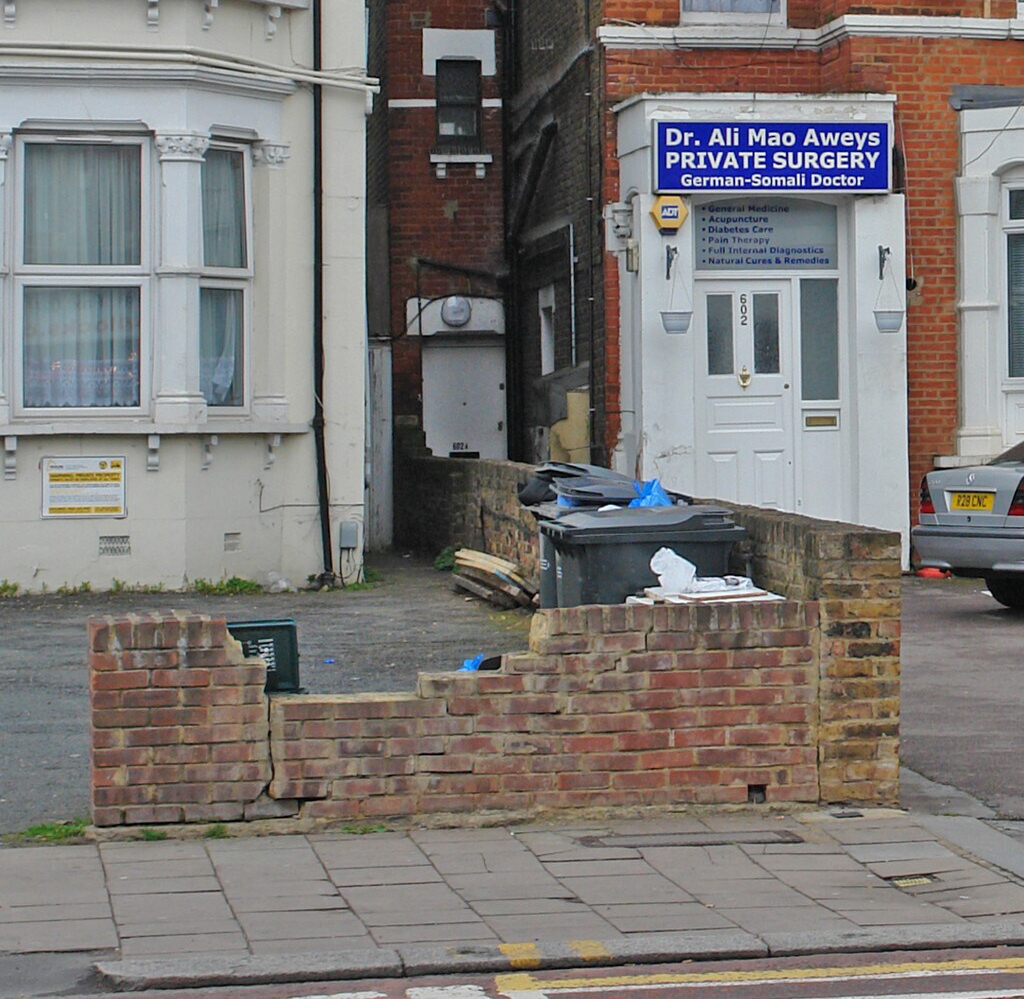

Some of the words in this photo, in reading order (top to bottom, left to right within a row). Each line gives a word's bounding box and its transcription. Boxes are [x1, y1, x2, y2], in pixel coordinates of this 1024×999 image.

[665, 128, 700, 146] Dr.
[708, 128, 739, 146] Ali
[748, 128, 796, 146] Mao
[803, 128, 880, 151] Aweys
[665, 152, 766, 169] PRIVATE
[773, 151, 880, 169] SURGERY
[681, 173, 806, 187] German-Somali
[811, 173, 864, 187] Doctor
[661, 207, 678, 216] ADT
[708, 205, 745, 213] General
[748, 205, 790, 213] Medicine
[708, 215, 769, 224] Acupuncture
[708, 226, 750, 234] Diabetes
[708, 236, 729, 244] Pain
[731, 236, 770, 245] Therapy
[769, 246, 824, 255] Diagnostics
[708, 257, 744, 265] Natural
[745, 257, 772, 265] Cures
[739, 294, 748, 326] 602
